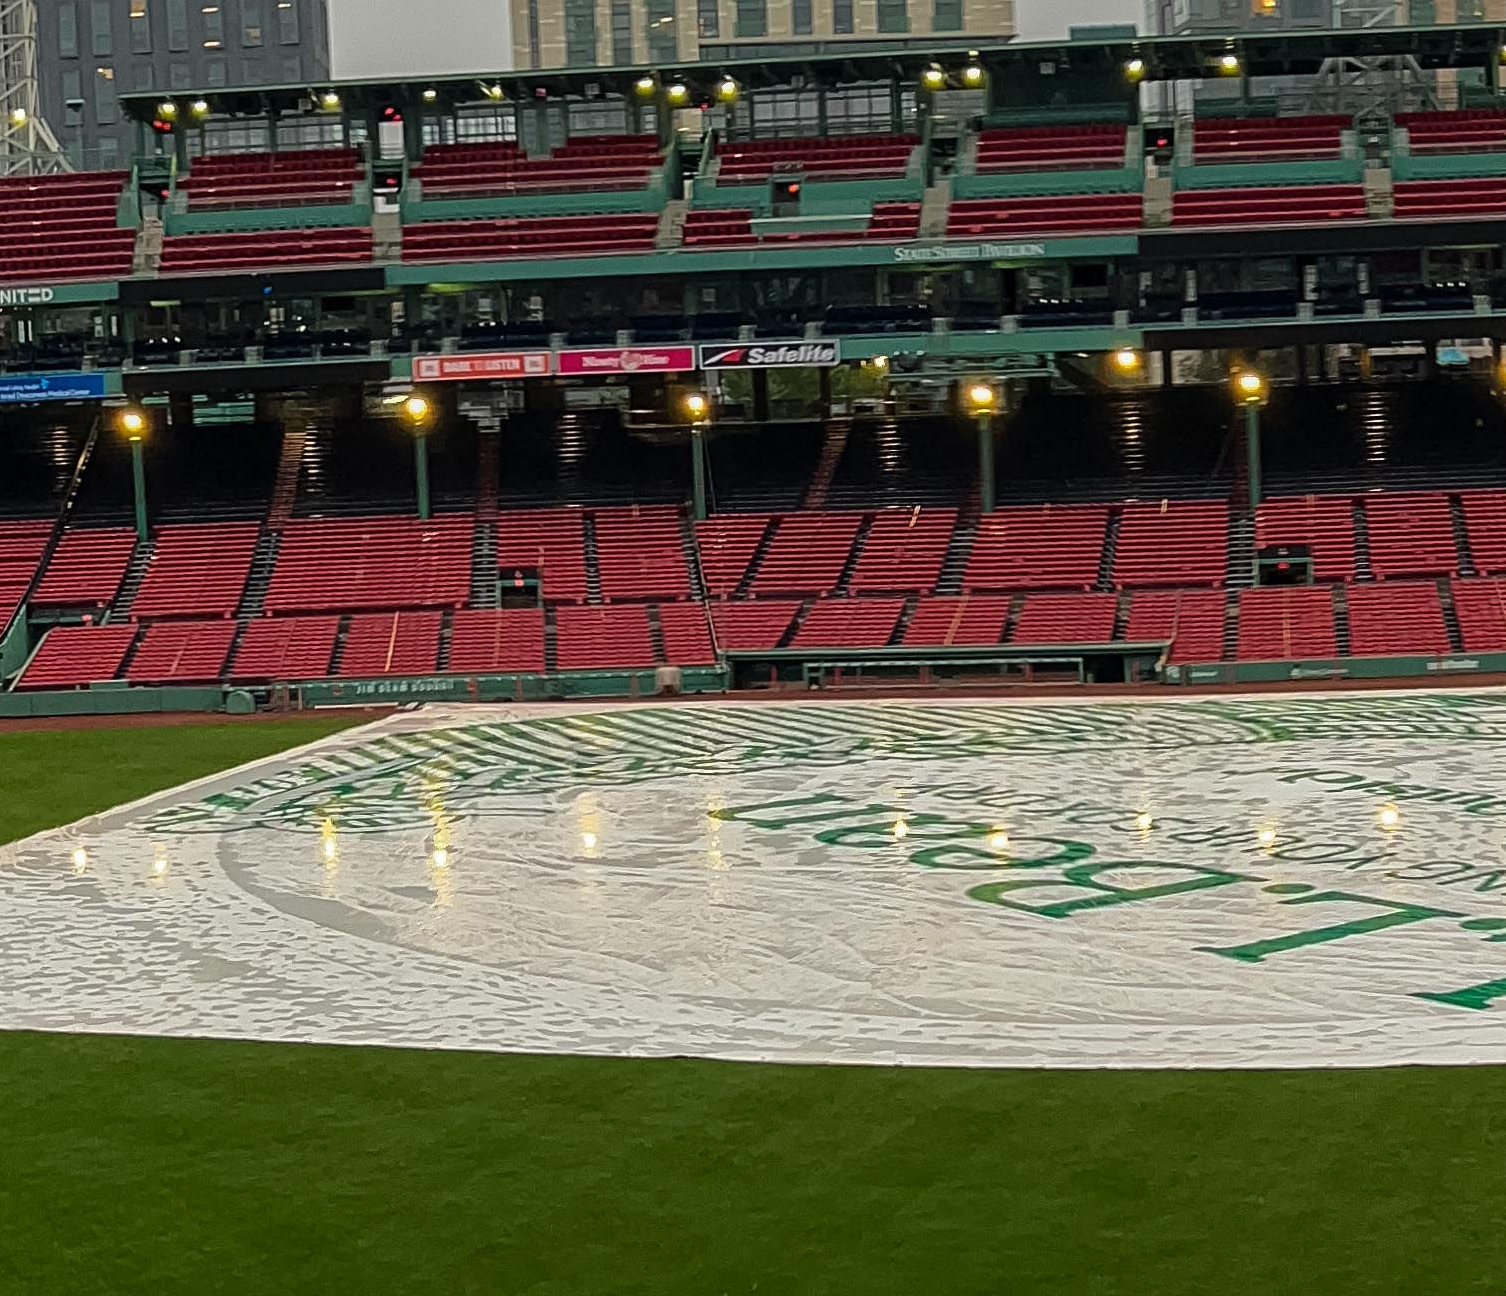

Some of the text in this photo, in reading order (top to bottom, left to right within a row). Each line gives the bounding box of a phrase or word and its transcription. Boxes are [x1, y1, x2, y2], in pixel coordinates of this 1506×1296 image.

[747, 344, 836, 364] Safelite
[893, 782, 1047, 812] DRY
[1035, 797, 1167, 833] SOX
[1171, 824, 1396, 871] YOUR
